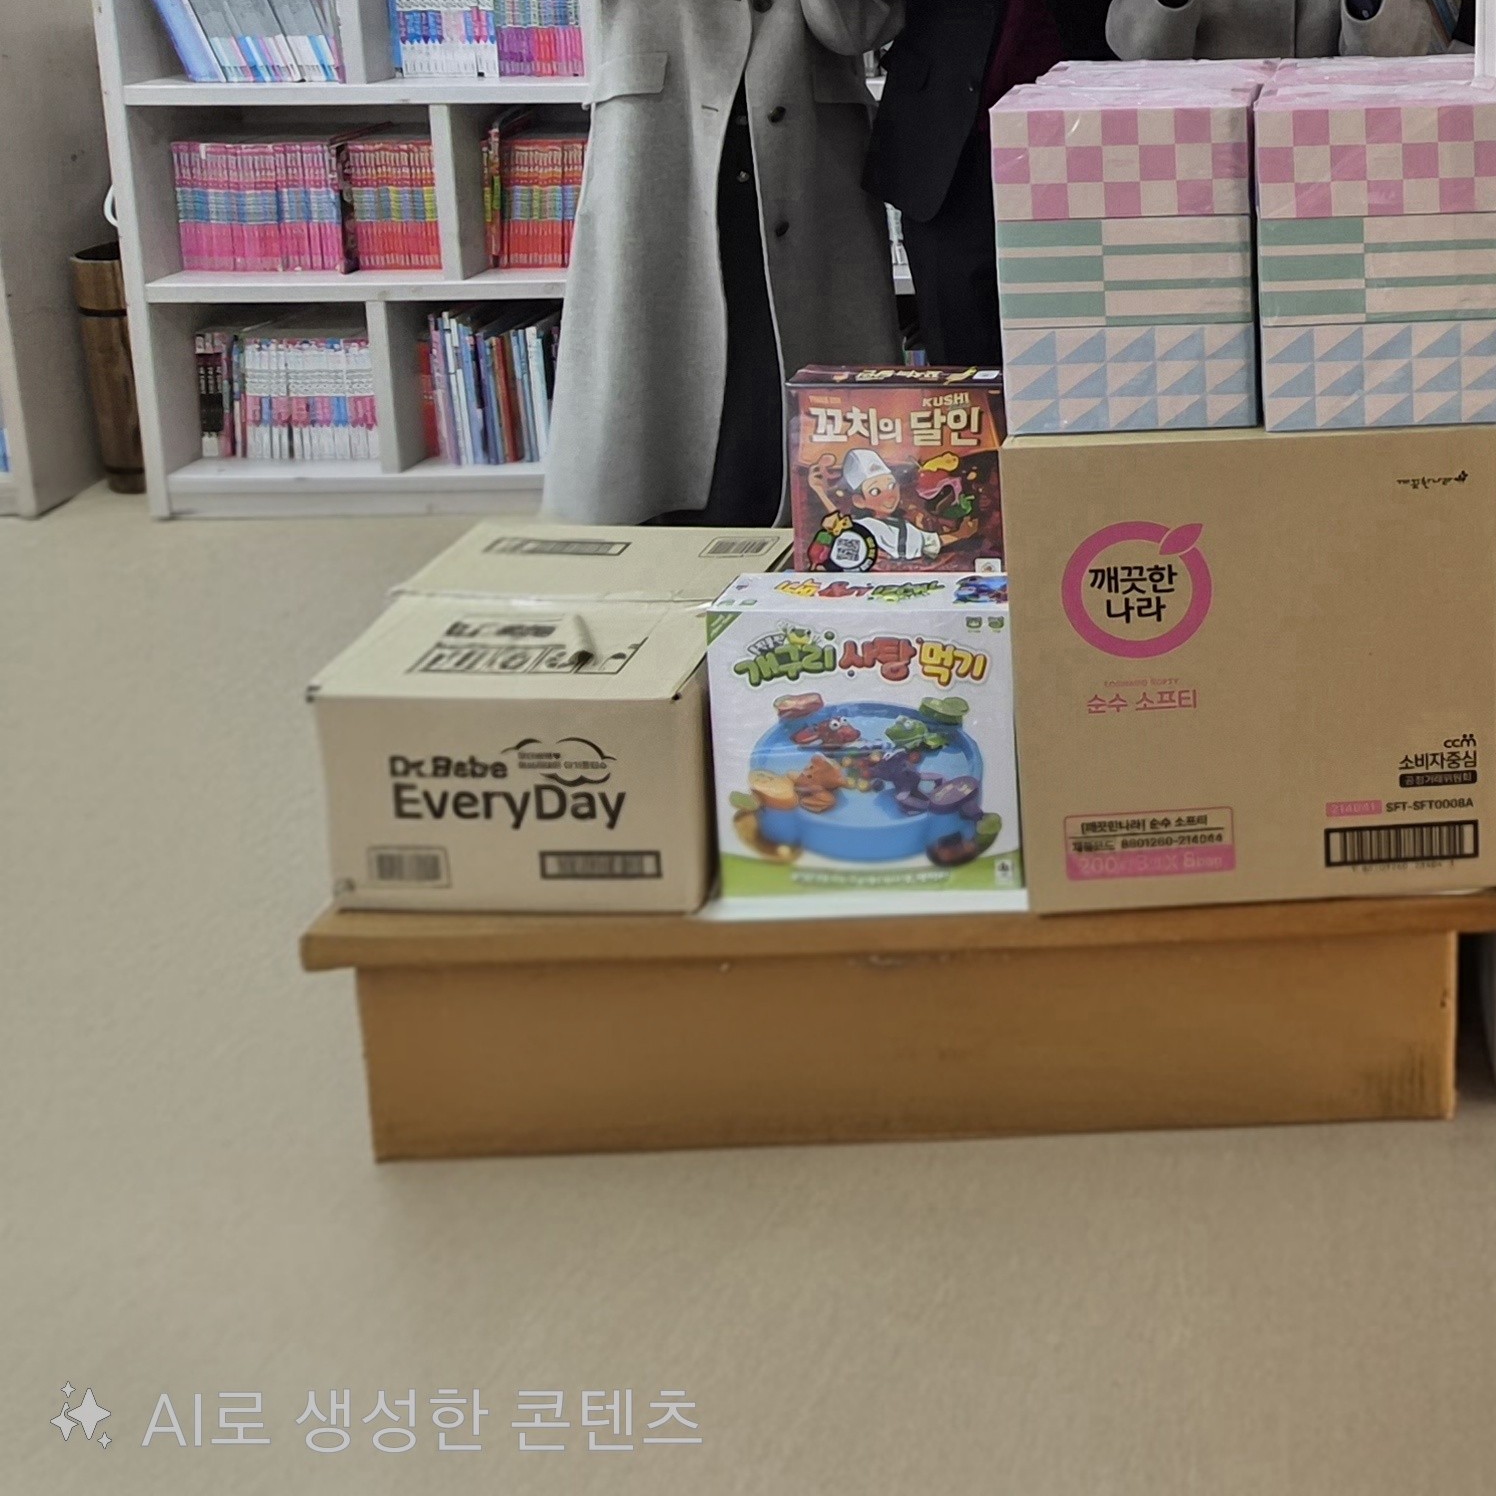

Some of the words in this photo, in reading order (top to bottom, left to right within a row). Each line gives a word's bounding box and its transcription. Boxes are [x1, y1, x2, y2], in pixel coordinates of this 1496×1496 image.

[922, 392, 970, 407] KUSHI
[808, 406, 902, 446] 꼬치의
[910, 406, 981, 446] 달인
[1088, 563, 1178, 595] 깨끗한
[1105, 596, 1166, 624] 나라
[733, 632, 837, 687] 개구리
[838, 636, 917, 682] 사탕
[918, 638, 987, 687] 먹기
[1087, 694, 1128, 714] 순수
[1135, 689, 1197, 711] 소프티
[1443, 733, 1477, 749] ccm
[389, 755, 508, 779] Dr.Bebe
[1398, 750, 1478, 771] 소비자중심
[393, 783, 627, 830] EveryDay
